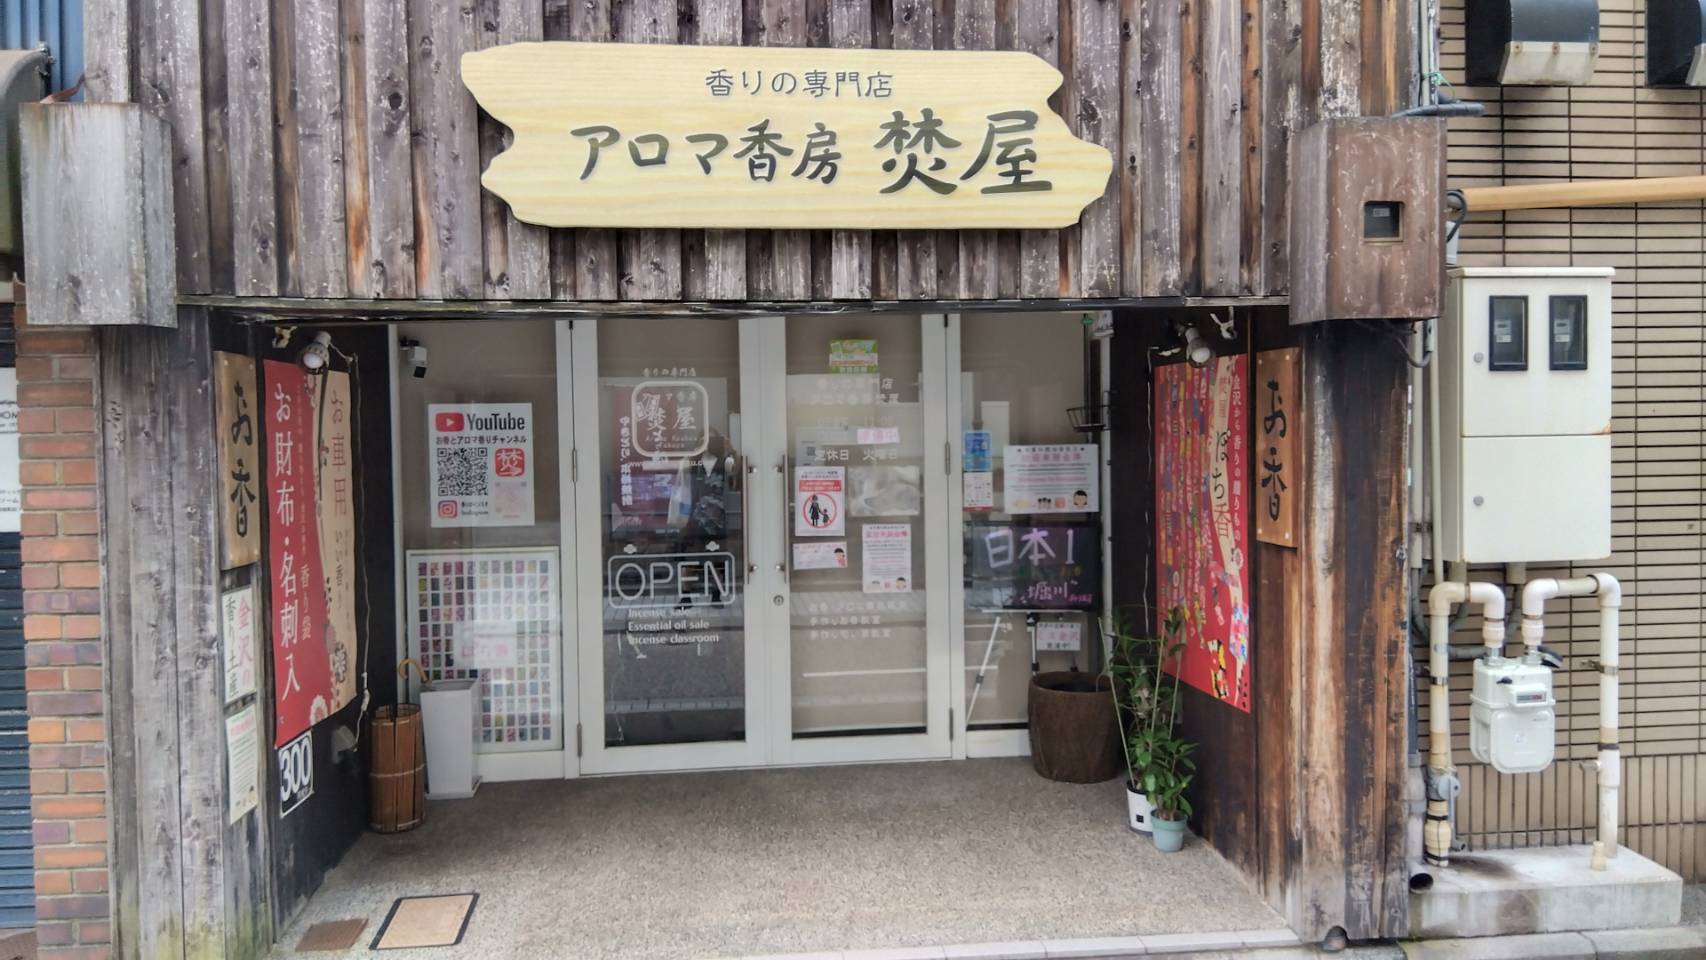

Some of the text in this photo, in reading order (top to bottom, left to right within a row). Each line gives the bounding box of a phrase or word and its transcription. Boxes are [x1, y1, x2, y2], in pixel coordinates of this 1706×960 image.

[705, 69, 893, 98] 香りの専門店
[570, 108, 1054, 195] アロマ香房 焚屋
[466, 412, 525, 431] YouTube
[231, 380, 257, 538] お香
[1261, 377, 1287, 521] お香
[615, 560, 730, 601] OPEN
[628, 606, 691, 617] Incense sale
[628, 619, 710, 631] Essential oil sale
[670, 633, 719, 643] classroom
[280, 736, 312, 802] 300
